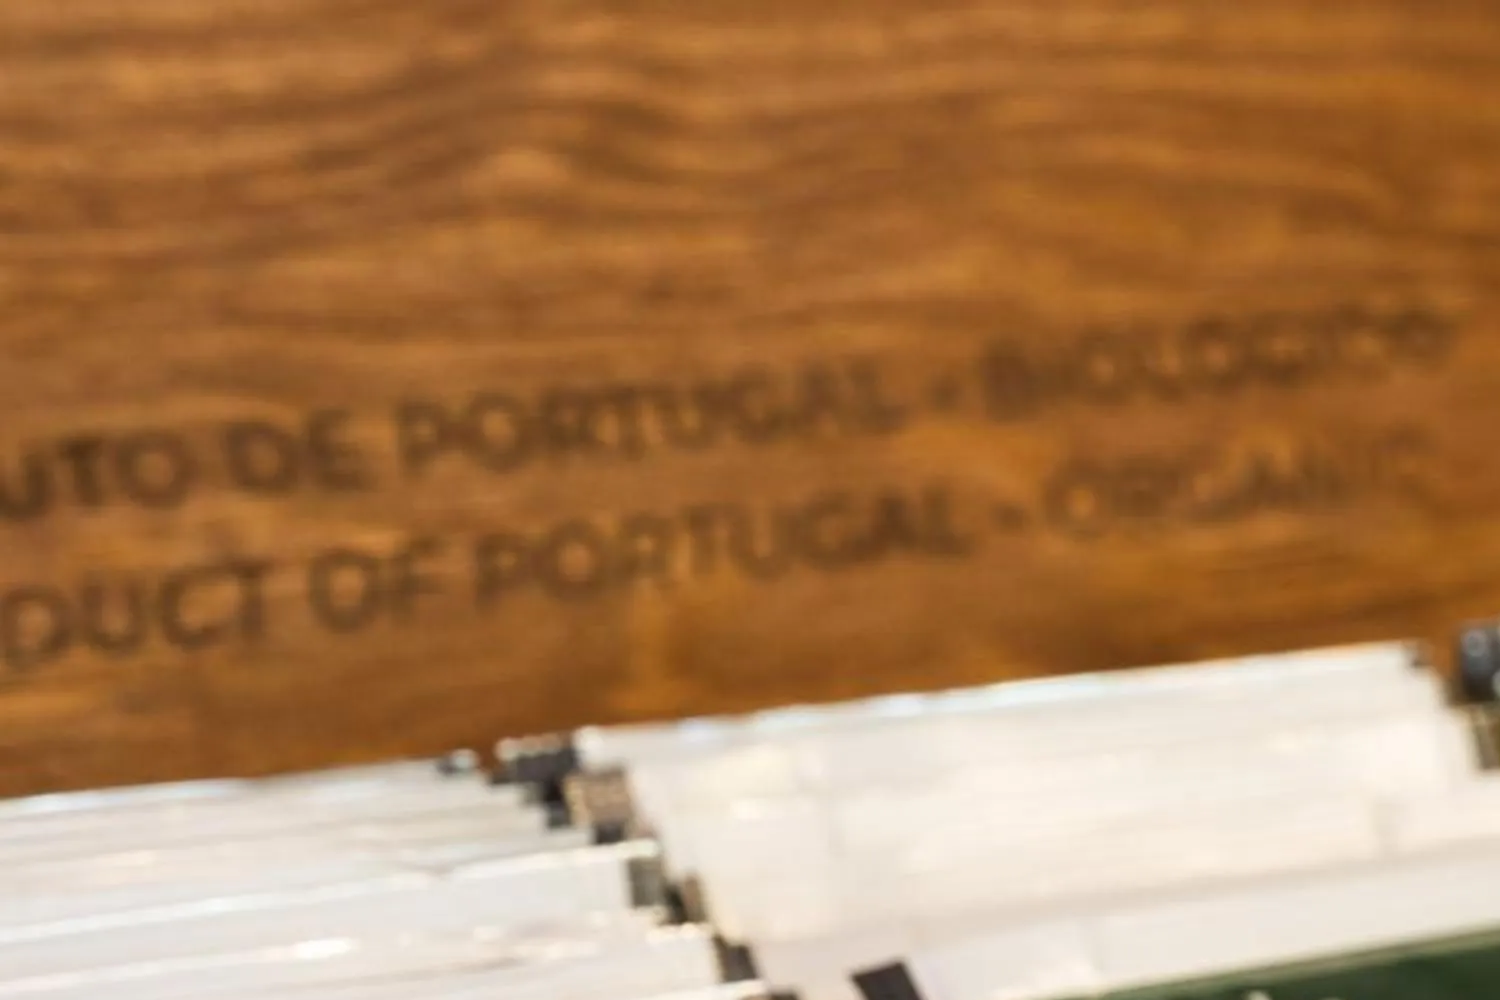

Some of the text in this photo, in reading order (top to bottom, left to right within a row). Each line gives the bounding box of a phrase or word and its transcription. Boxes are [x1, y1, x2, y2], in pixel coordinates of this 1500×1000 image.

[221, 403, 374, 497] DE
[396, 360, 907, 475] PORTUGAL
[308, 533, 445, 634] OF
[474, 485, 974, 612] PORTUGAL
